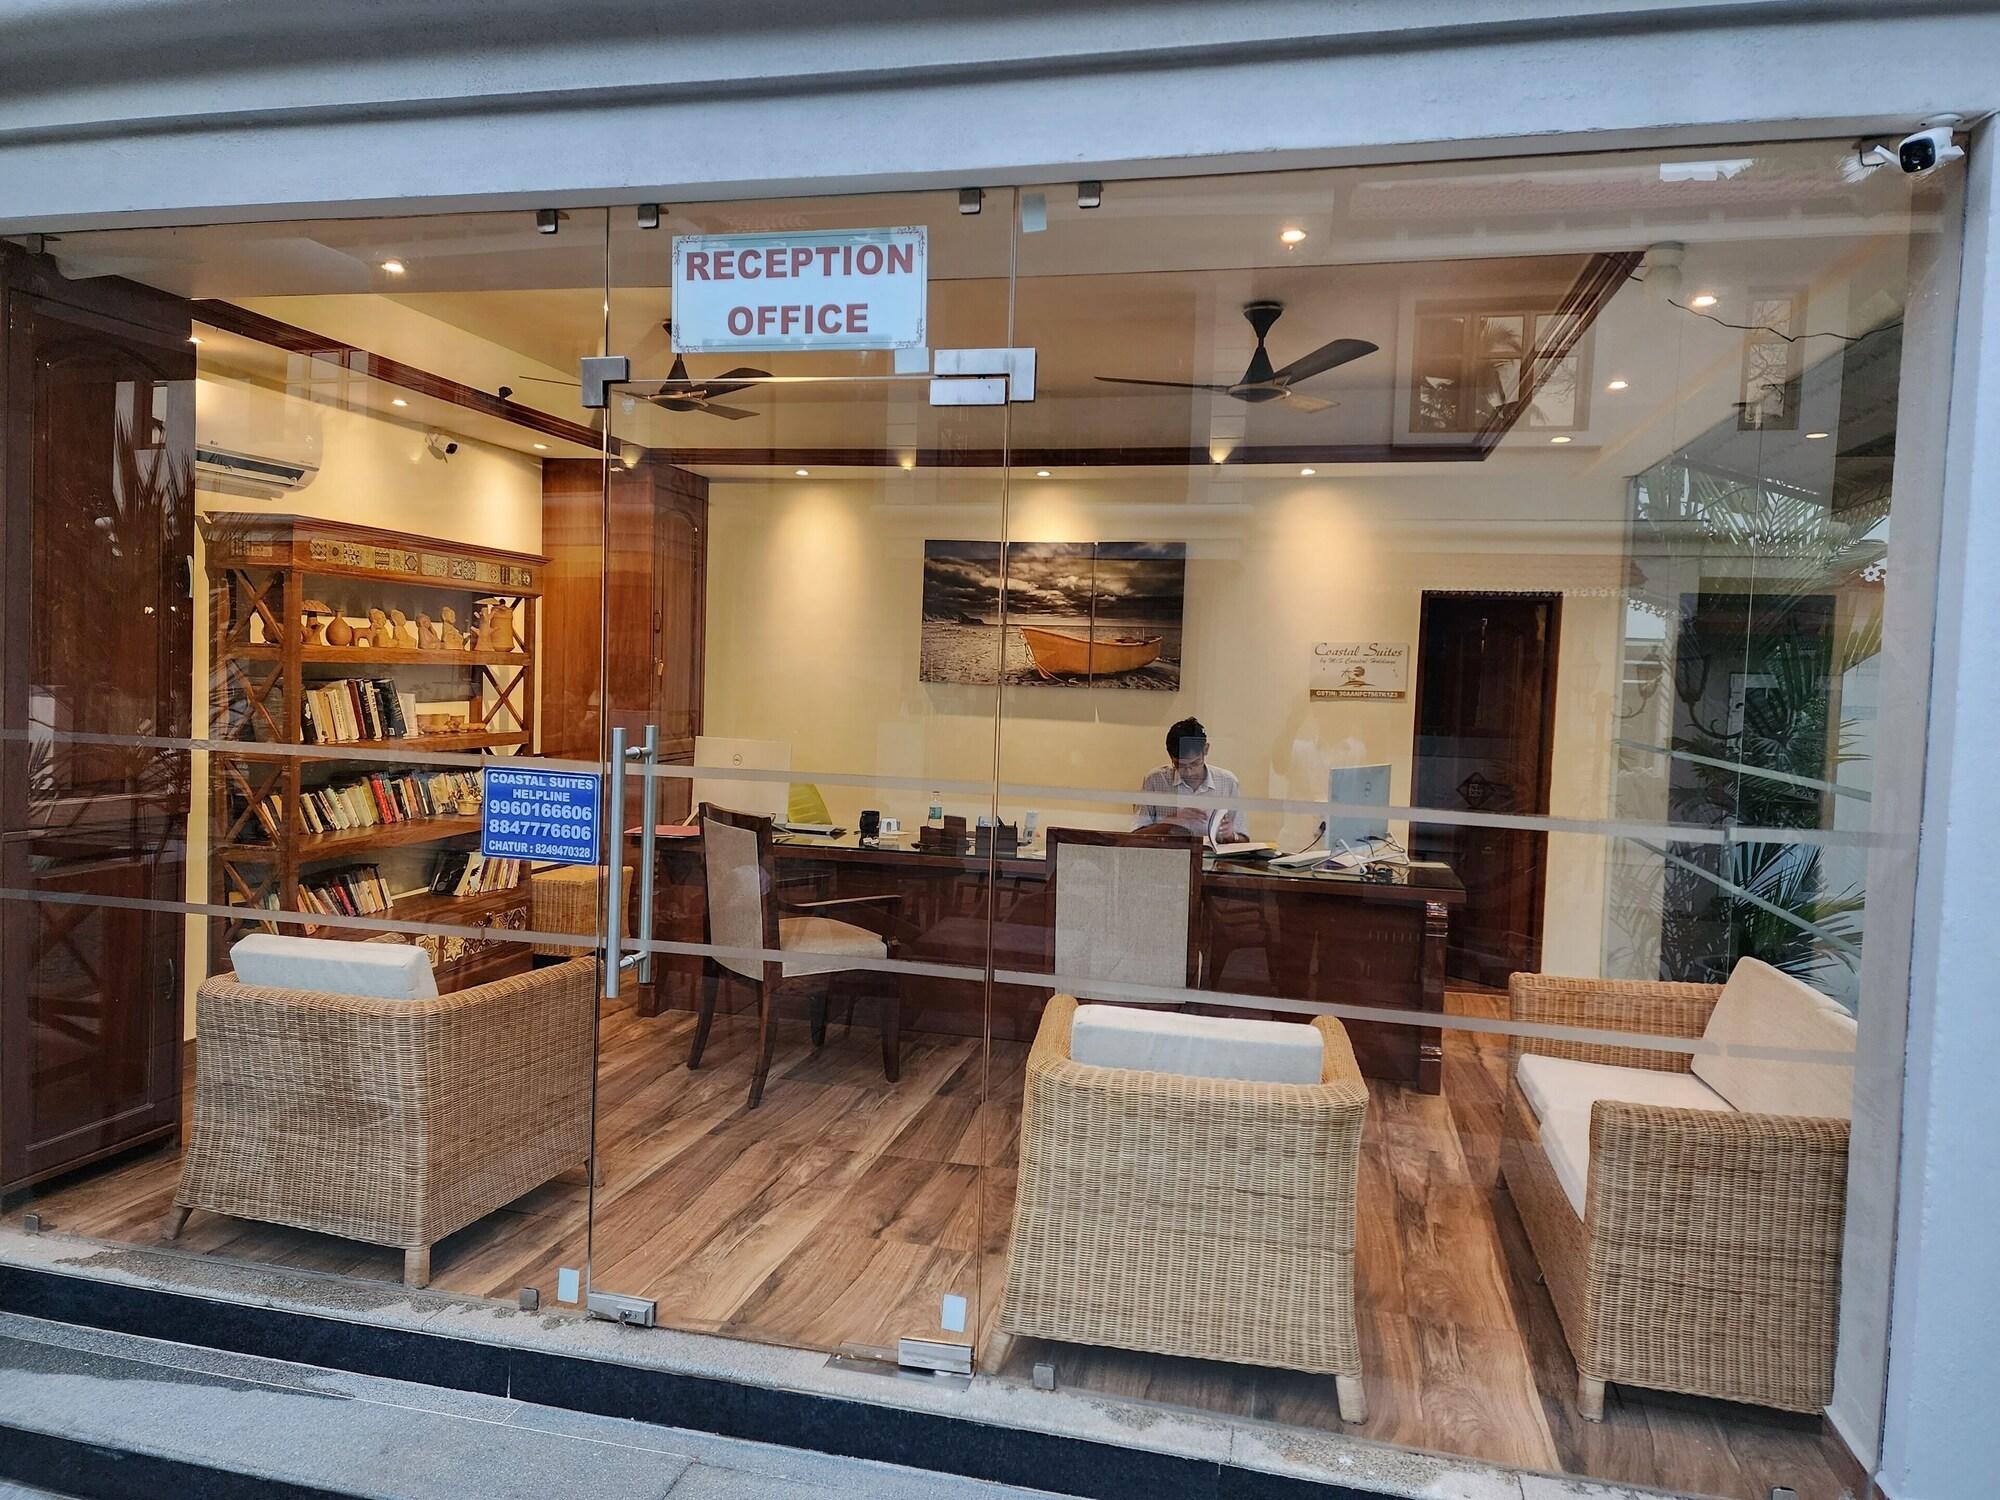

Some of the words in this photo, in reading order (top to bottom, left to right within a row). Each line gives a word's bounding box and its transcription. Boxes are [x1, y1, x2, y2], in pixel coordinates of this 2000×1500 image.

[685, 243, 914, 281] RECEPTION
[727, 303, 869, 336] OFFICE
[1315, 643, 1360, 657] Coastal
[1363, 642, 1403, 657] Suites
[490, 773, 546, 786] COASTAL
[549, 776, 594, 790] SUITES
[512, 788, 571, 802] HELPLINE
[489, 799, 593, 820] 9960166606
[489, 819, 592, 840] 8847776606
[535, 843, 591, 858] 8249470328
